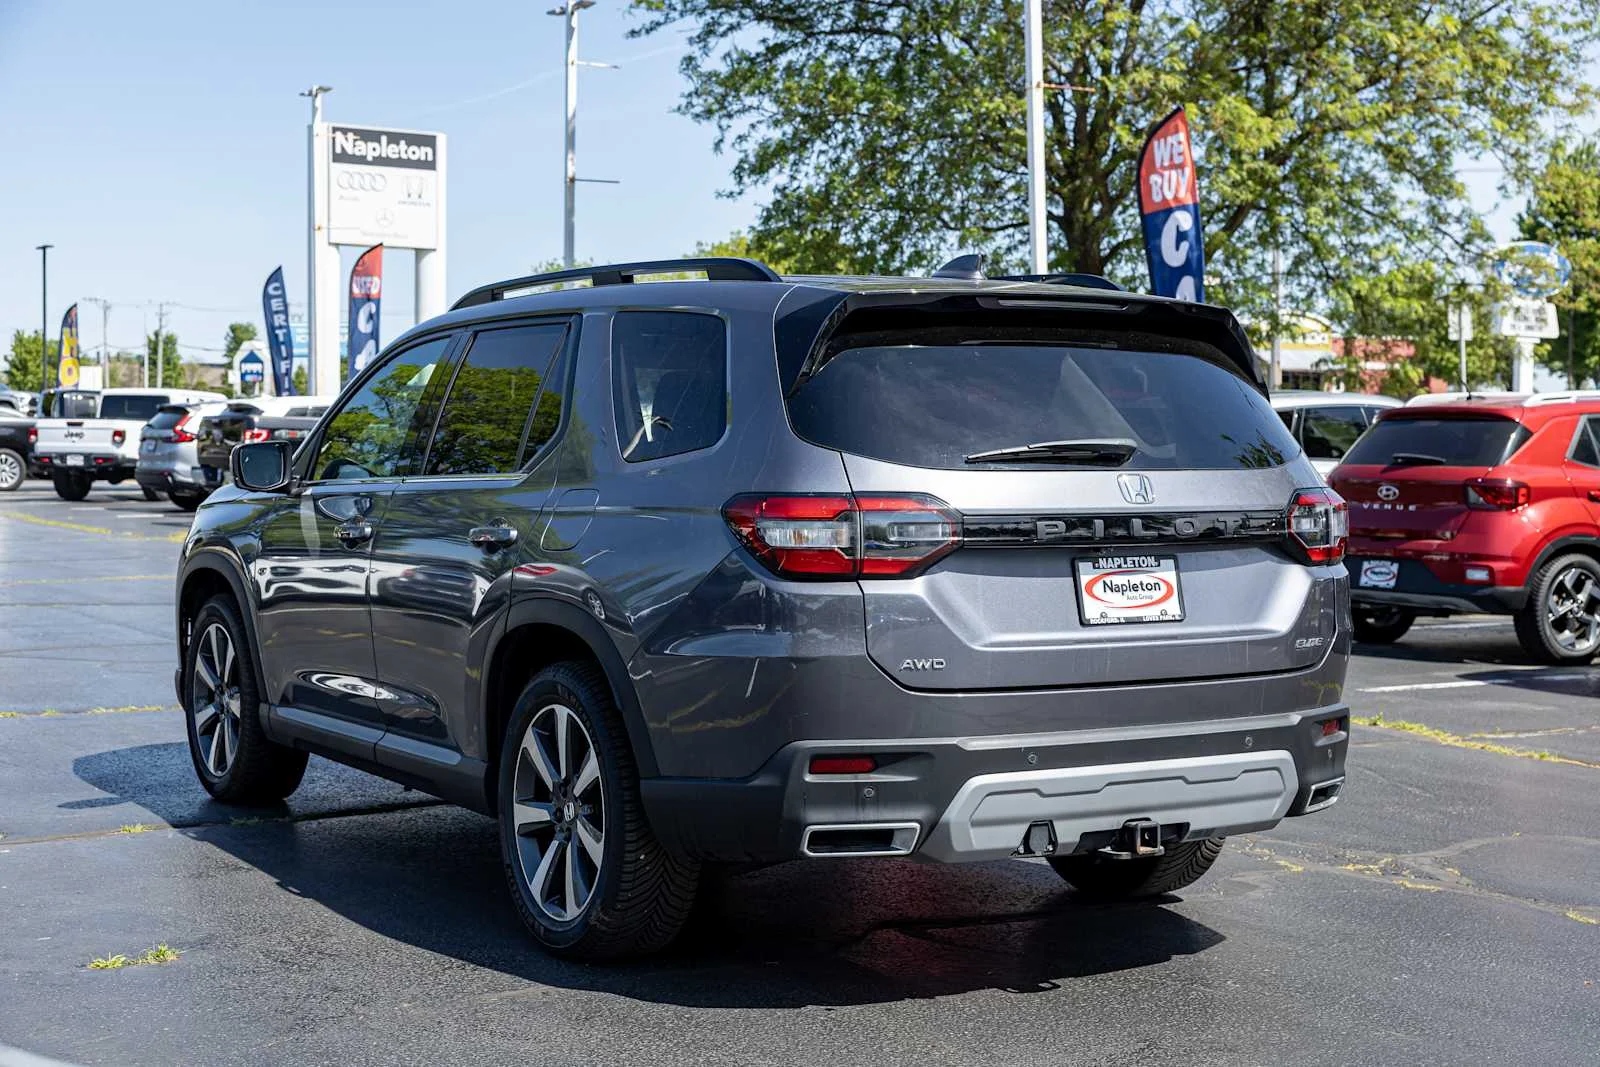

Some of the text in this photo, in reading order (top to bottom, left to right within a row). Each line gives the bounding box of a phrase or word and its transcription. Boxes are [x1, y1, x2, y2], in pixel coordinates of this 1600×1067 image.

[334, 131, 434, 162] Napleton
[1153, 132, 1184, 168] WE
[1149, 167, 1190, 203] BUY
[64, 429, 85, 440] Jeep
[1362, 502, 1417, 512] VENUE
[1036, 516, 1242, 541] PILOT
[1098, 556, 1156, 569] NAPLETON
[1102, 579, 1161, 596] Napleton
[900, 658, 946, 670] AWD
